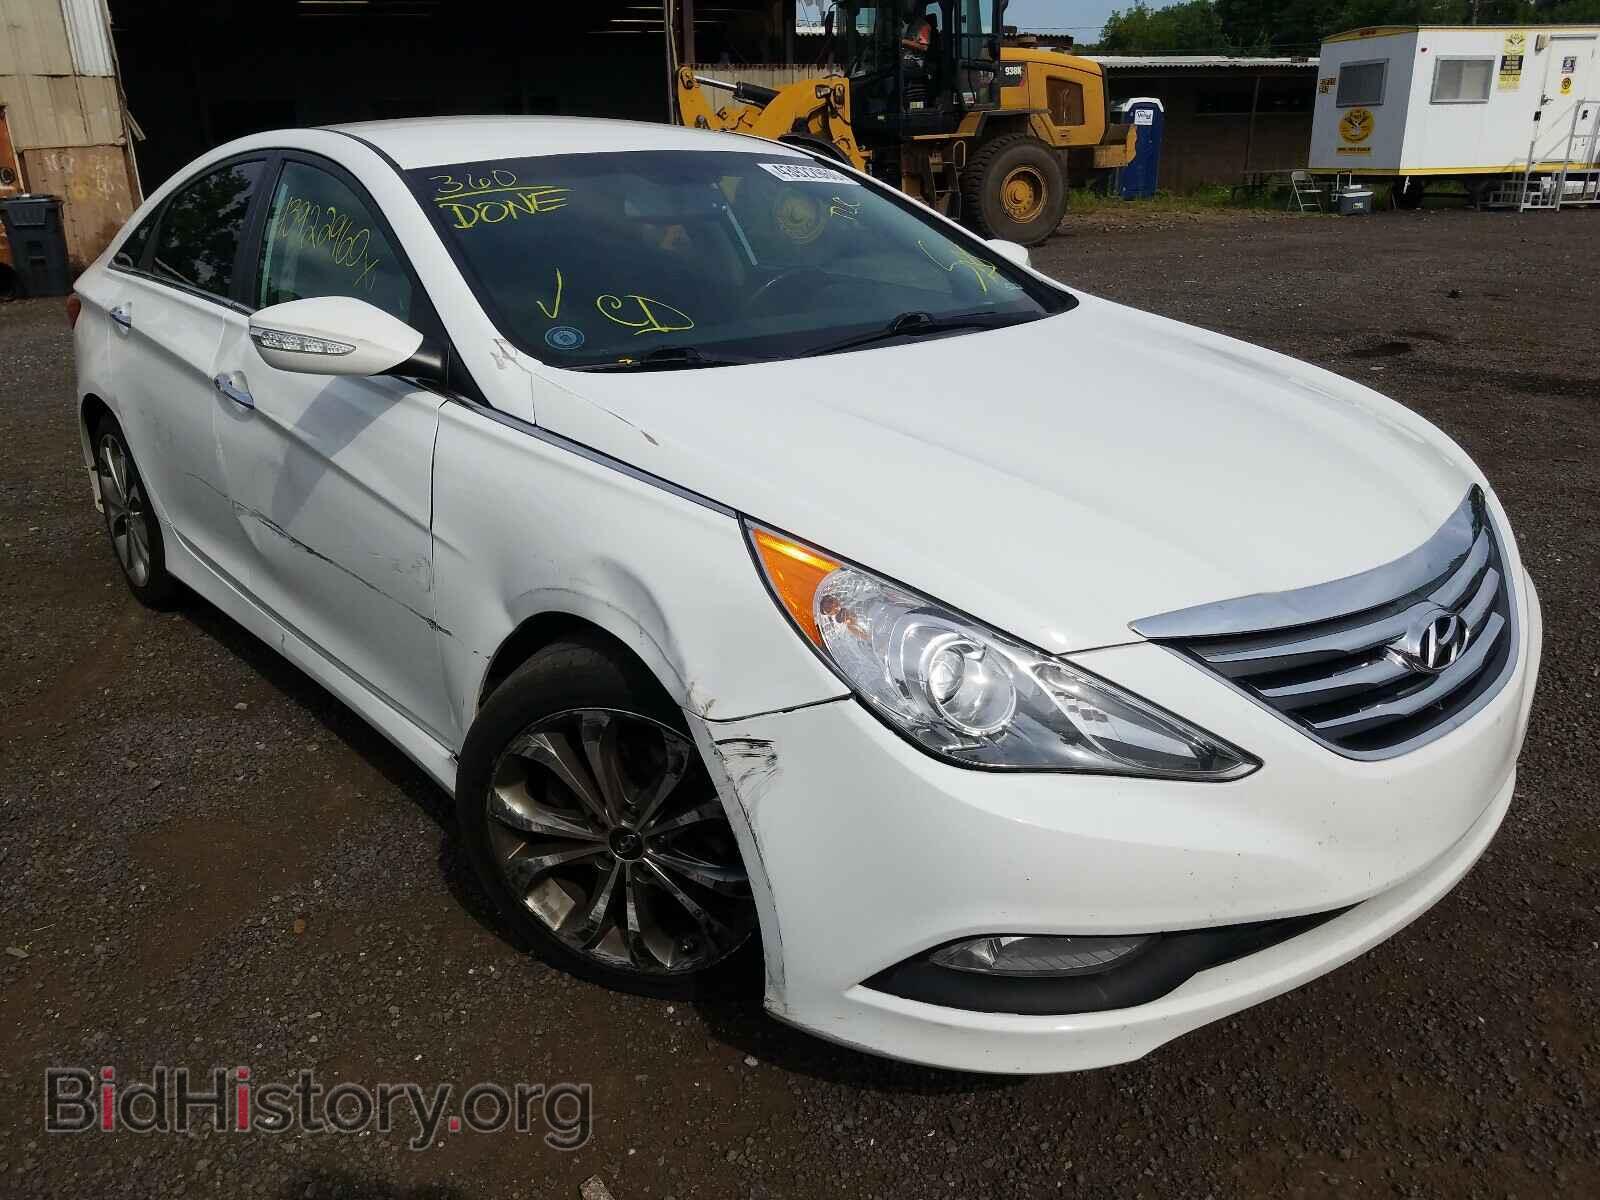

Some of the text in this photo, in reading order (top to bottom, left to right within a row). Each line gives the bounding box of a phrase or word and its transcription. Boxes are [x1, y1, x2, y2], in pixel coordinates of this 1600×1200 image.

[429, 169, 518, 194] 360
[438, 190, 569, 230] DONE
[595, 294, 695, 335] CD
